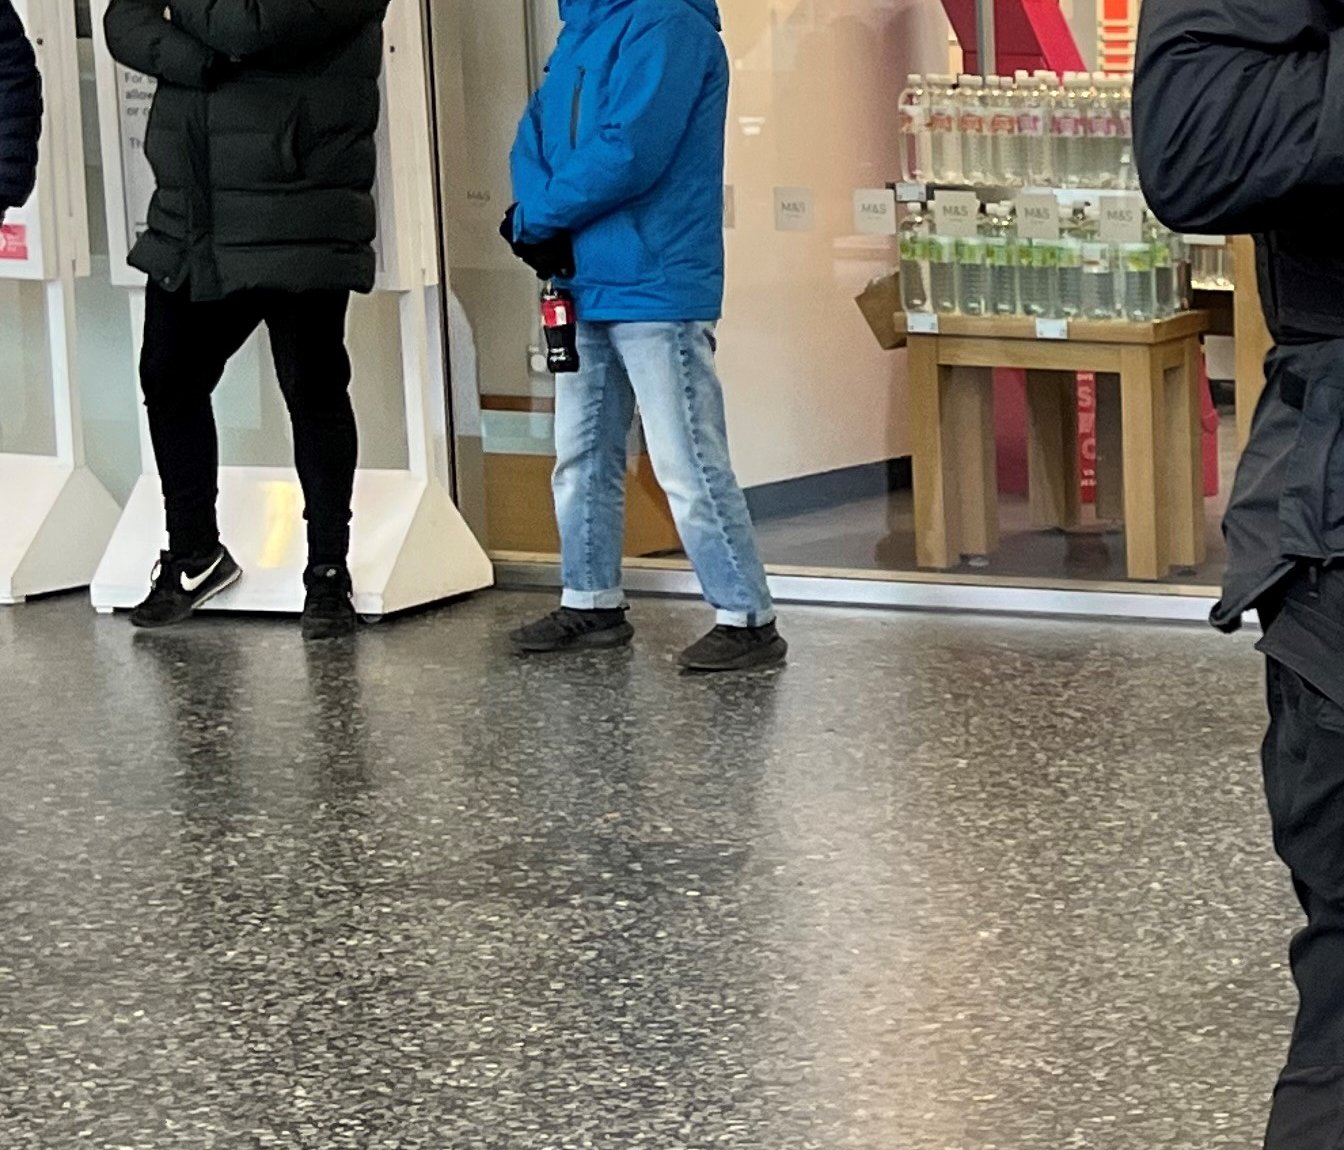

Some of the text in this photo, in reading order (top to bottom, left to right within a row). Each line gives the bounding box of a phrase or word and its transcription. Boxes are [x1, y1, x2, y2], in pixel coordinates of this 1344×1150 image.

[781, 202, 806, 213] M&S
[861, 203, 887, 214] M&S
[942, 205, 968, 216] M&S
[1024, 207, 1050, 218] M&S
[1106, 211, 1132, 222] M&S
